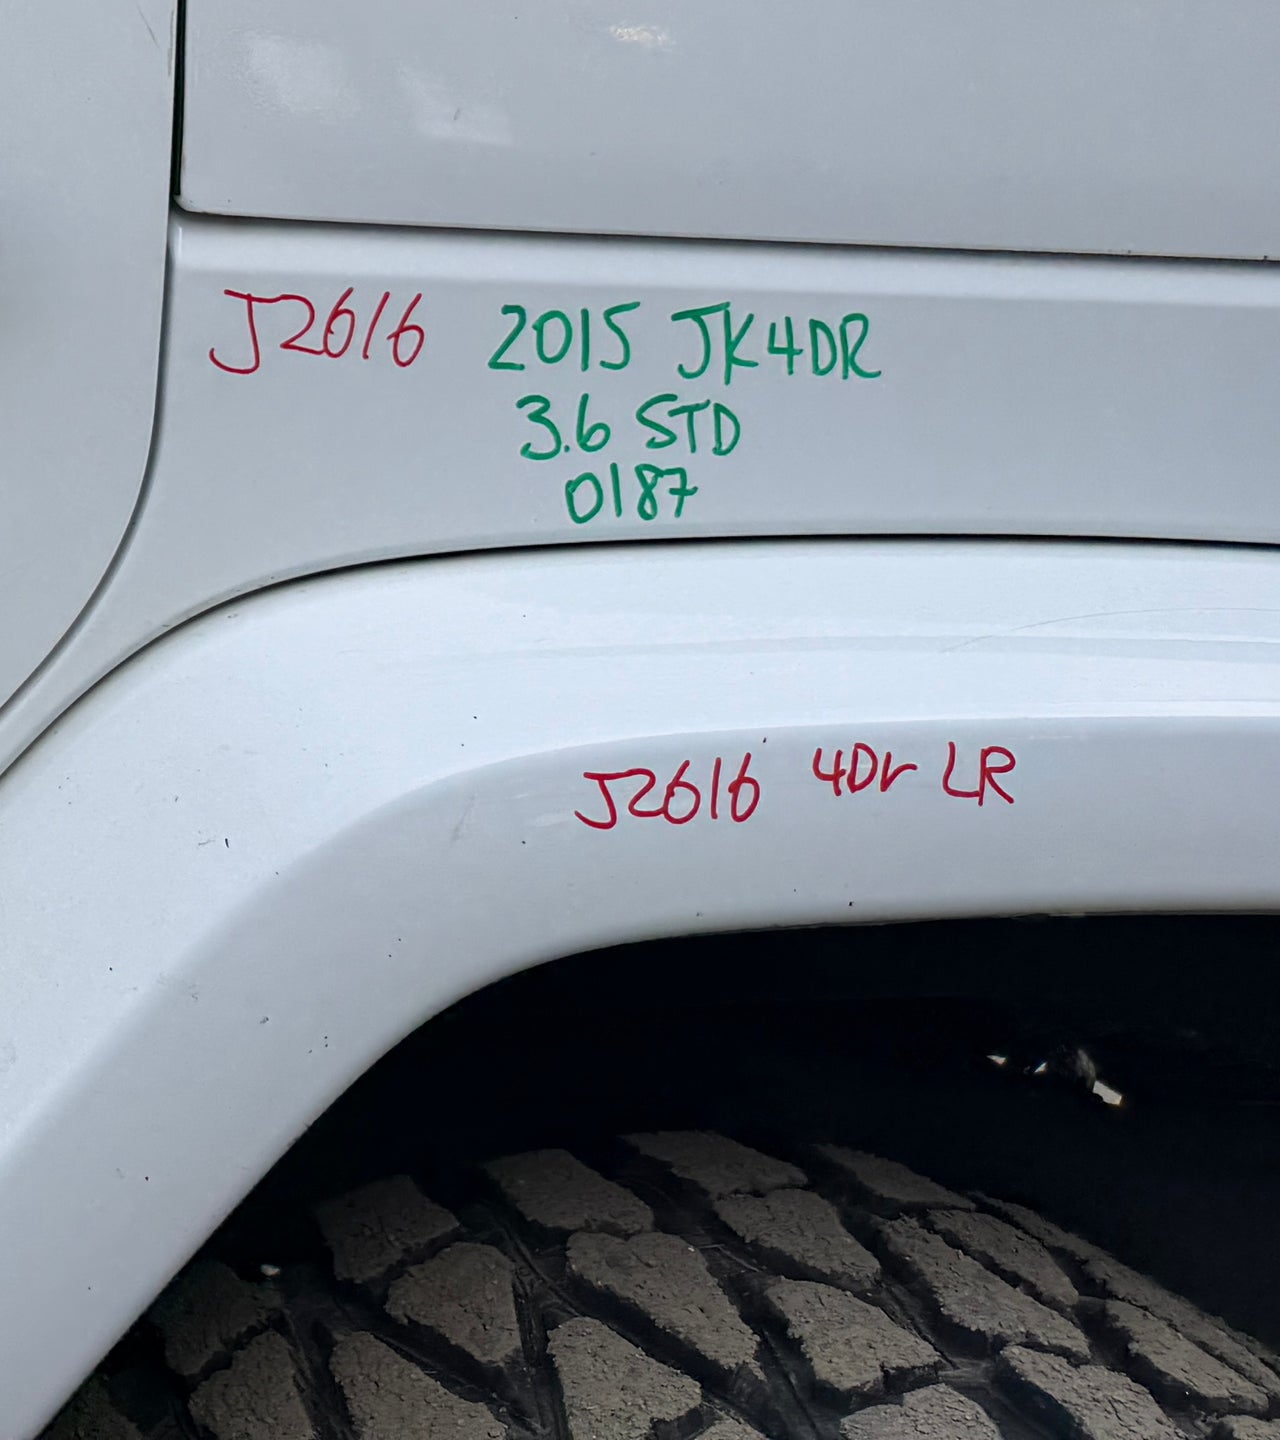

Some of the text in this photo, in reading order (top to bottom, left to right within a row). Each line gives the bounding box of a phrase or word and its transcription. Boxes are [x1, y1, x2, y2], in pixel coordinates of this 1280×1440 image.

[209, 288, 425, 375] J2616
[488, 301, 641, 372] 2015
[516, 392, 742, 462] 3.6 STD
[565, 463, 699, 525] 0187
[576, 753, 760, 830] J2616
[943, 742, 1016, 805] LR
